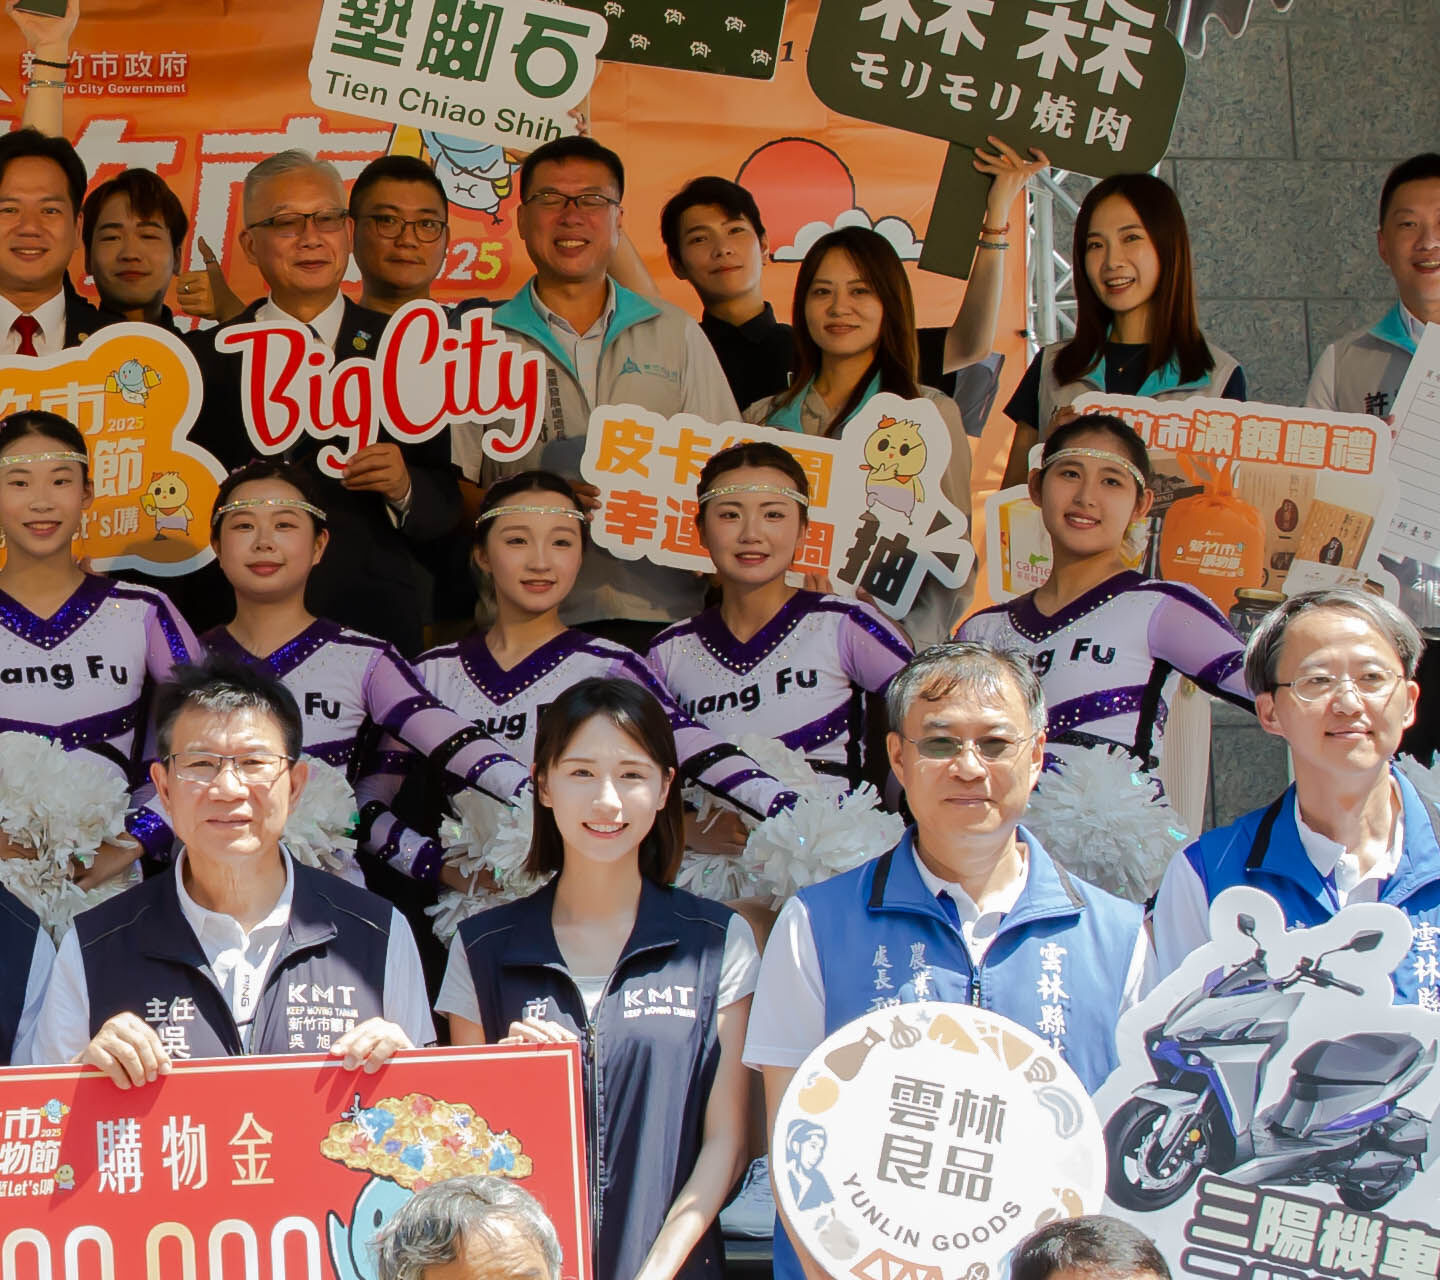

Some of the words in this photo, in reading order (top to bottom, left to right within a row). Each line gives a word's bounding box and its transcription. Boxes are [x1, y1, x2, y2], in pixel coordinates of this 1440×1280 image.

[80, 83, 106, 96] City
[108, 83, 187, 95] Government
[851, 51, 1132, 151] モリモリ焼肉
[325, 70, 389, 104] Tien
[397, 86, 486, 127] Chiao
[494, 107, 563, 142] Shih
[223, 307, 547, 470] BigCity
[107, 415, 145, 434] 2025
[837, 512, 919, 607] 抽
[1069, 638, 1115, 665] Fu
[86, 655, 128, 684] Fu
[776, 667, 818, 695] Fu
[304, 692, 340, 719] Fu
[287, 983, 357, 1007] KMT
[624, 985, 696, 1007] KMT
[144, 997, 195, 1023] 主任
[890, 1075, 1008, 1144] 雲林
[40, 1129, 62, 1138] 2025
[95, 1112, 276, 1195] 購物金
[877, 1133, 994, 1202] 良品
[843, 1172, 921, 1249] YUNLIN
[933, 1200, 1024, 1252] GOODS
